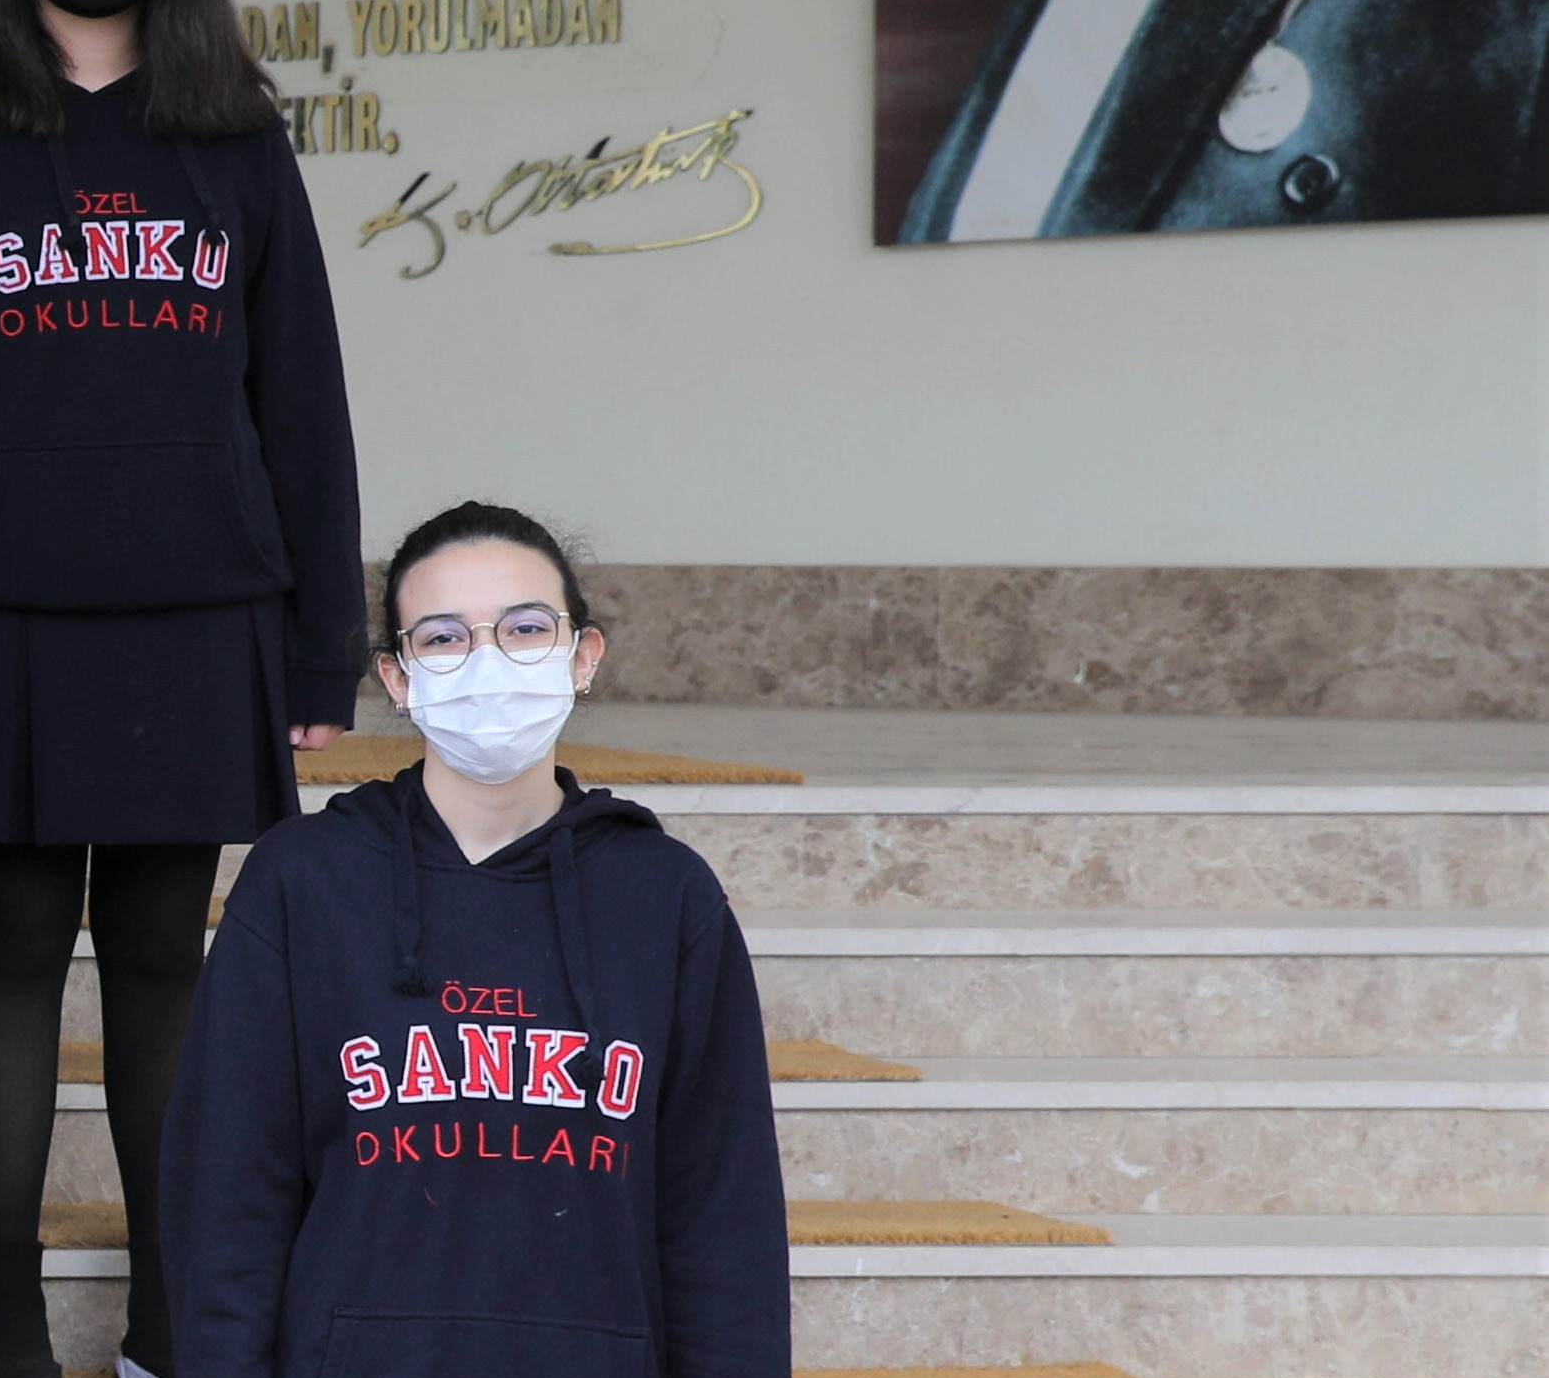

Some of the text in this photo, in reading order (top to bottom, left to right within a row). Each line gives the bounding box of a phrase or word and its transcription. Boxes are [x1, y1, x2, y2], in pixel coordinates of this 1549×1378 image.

[242, 2, 334, 74] DAN,
[0, 299, 223, 338] OKULLARI
[442, 980, 538, 1018] ÖZEL
[340, 1022, 644, 1121] SANKO
[356, 1122, 631, 1180] OKULLARI
